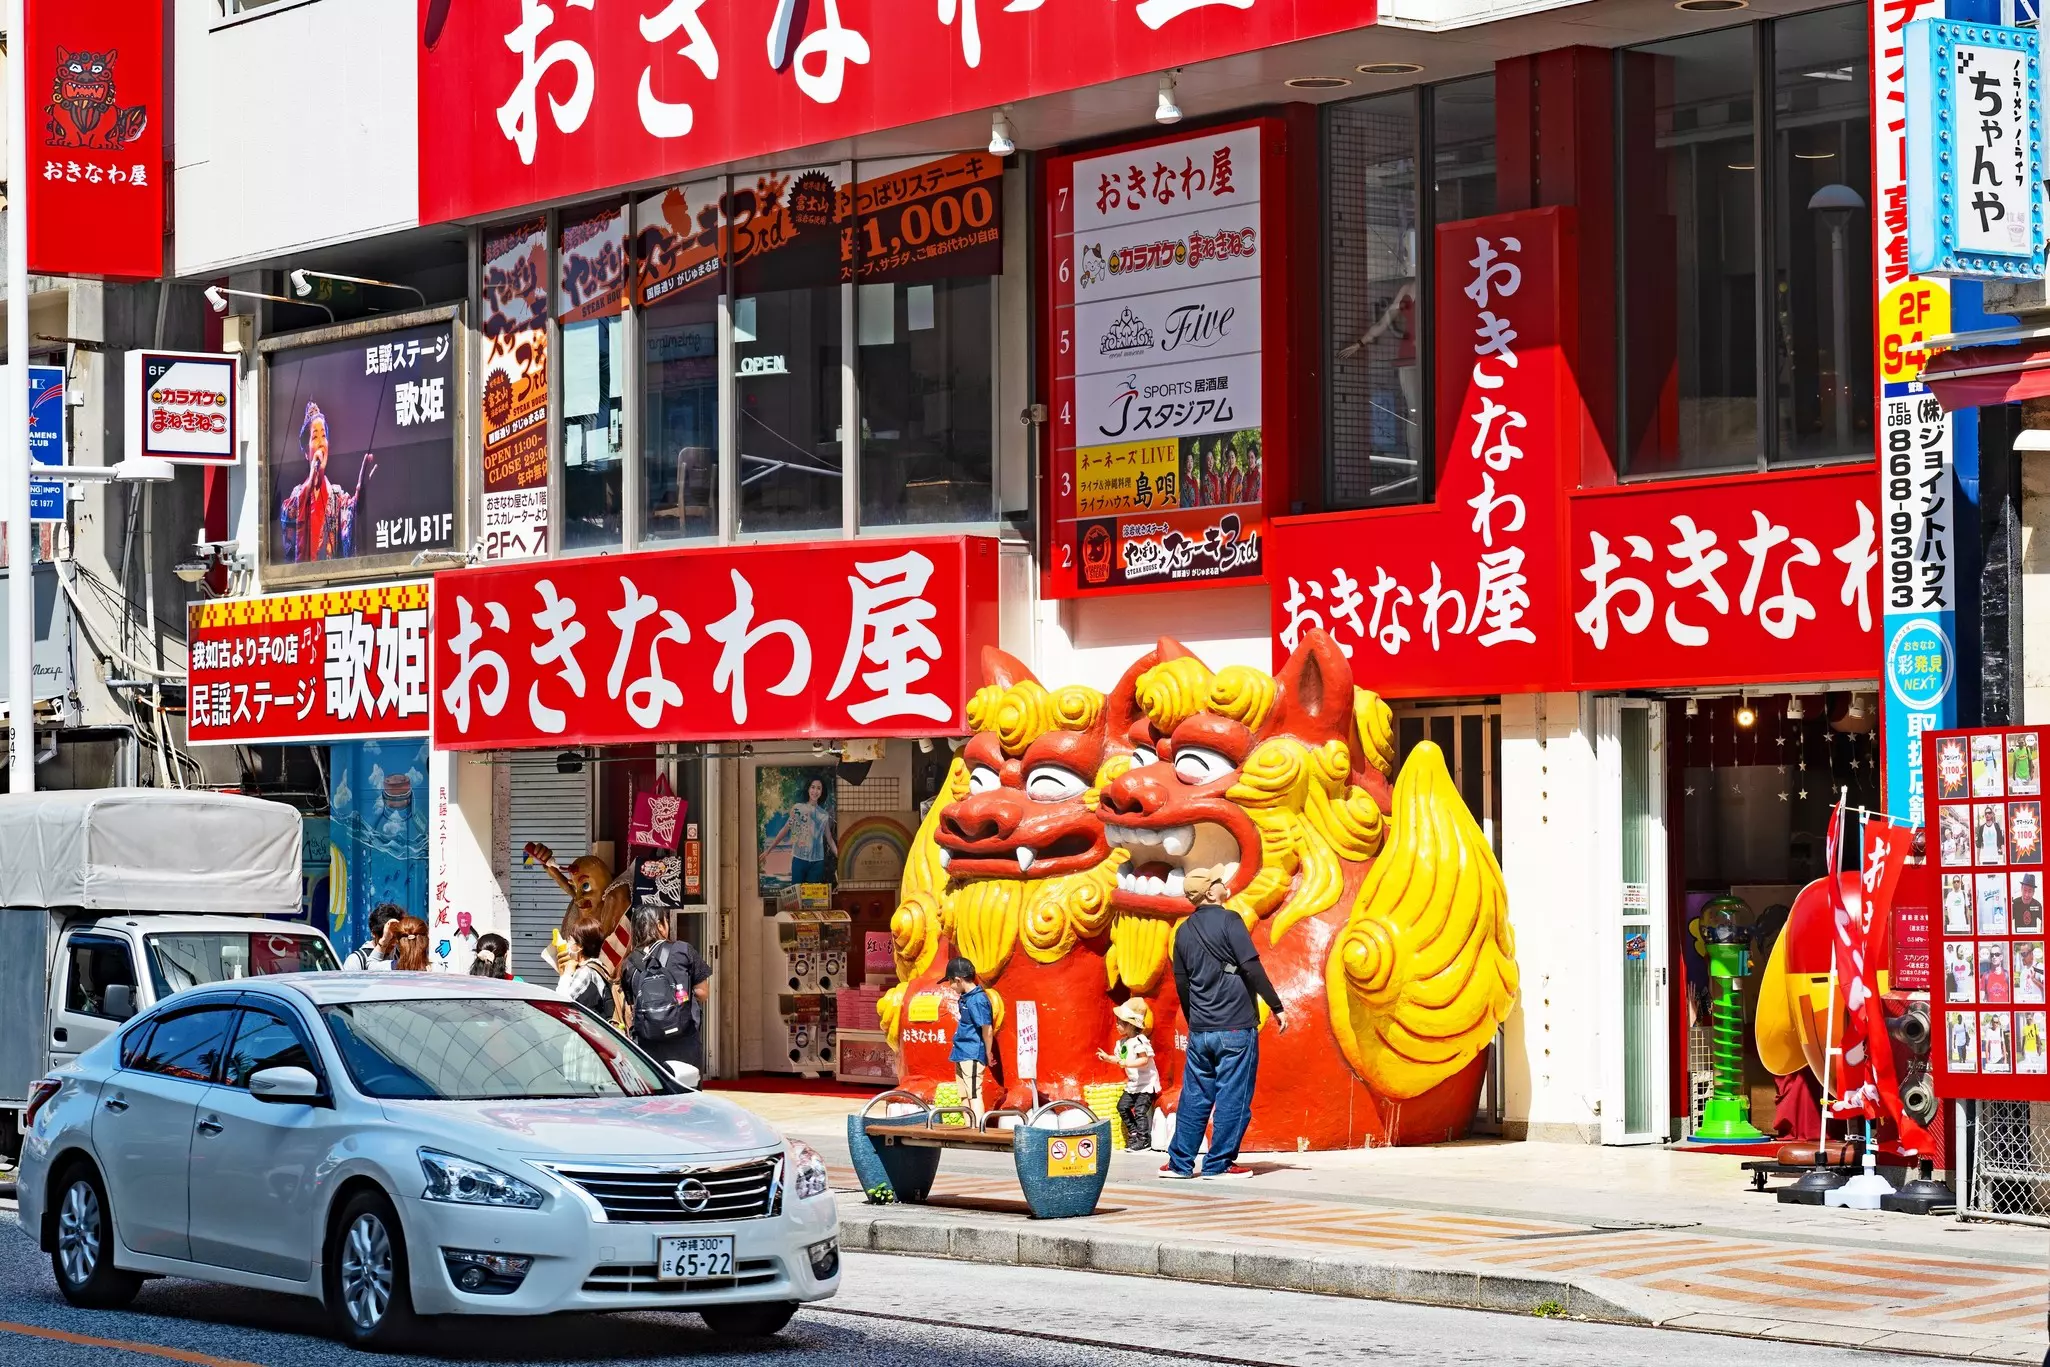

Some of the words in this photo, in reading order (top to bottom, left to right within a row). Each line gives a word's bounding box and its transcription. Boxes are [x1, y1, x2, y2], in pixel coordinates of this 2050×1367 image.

[1969, 71, 2006, 233] ちゃんや
[43, 160, 148, 187] おきなわ屋
[1096, 146, 1236, 215] おきなわ屋
[795, 193, 830, 213] 富士山
[1058, 187, 1069, 213] 7
[1119, 240, 1176, 275] カラオケ
[1187, 227, 1257, 269] まねきねこ
[677, 257, 719, 286] がじゅまる店
[1059, 258, 1070, 283] 6
[582, 299, 606, 318] STEAK
[1899, 290, 1931, 326] 2F
[1161, 304, 1236, 352] Five
[365, 332, 450, 376] 民謡ステージ
[1059, 330, 1070, 355] 5
[148, 366, 166, 376] 6F
[741, 355, 786, 373] OPEN
[162, 389, 217, 407] カラオケ
[1143, 381, 1192, 399] SPORTS
[1194, 376, 1229, 394] 居酒屋
[395, 377, 445, 427] 歌姫
[512, 403, 531, 417] STEAK
[1060, 401, 1071, 425] 4
[1888, 402, 1910, 414] TEL
[151, 407, 227, 434] まねきねこ
[1887, 414, 1912, 427] 098
[1463, 236, 1537, 649] おきなわ屋
[484, 445, 512, 470] OPEN
[1081, 450, 1137, 471] ネーネーズ
[1141, 445, 1176, 465] LIVE
[489, 457, 522, 484] CLOSE
[1061, 472, 1071, 497] 3
[1133, 471, 1178, 509] 島唄
[40, 500, 54, 508] 1977
[1080, 496, 1131, 513] ライブハウス
[487, 508, 548, 527] エスカレーターより
[1889, 429, 1914, 608] 868-9393
[375, 517, 418, 549] 当ビル
[420, 513, 453, 543] B1F
[487, 531, 527, 559] 2Fへ
[1061, 543, 1072, 569] 2
[1126, 567, 1142, 577] STEAK
[192, 633, 299, 671] 我如古より子の店
[442, 550, 953, 734] おきなわ屋
[1904, 640, 1936, 651] おきなわ
[324, 607, 429, 722] 歌姫
[1897, 654, 1943, 675] 彩発見
[1904, 675, 1937, 691] NEXT
[190, 676, 317, 728] 民謡ステージ
[434, 880, 450, 928] 歌姫
[902, 1028, 947, 1045] おきなわ屋
[677, 1239, 698, 1251] 沖縄
[700, 1239, 718, 1251] 300
[675, 1253, 730, 1276] 65-22
